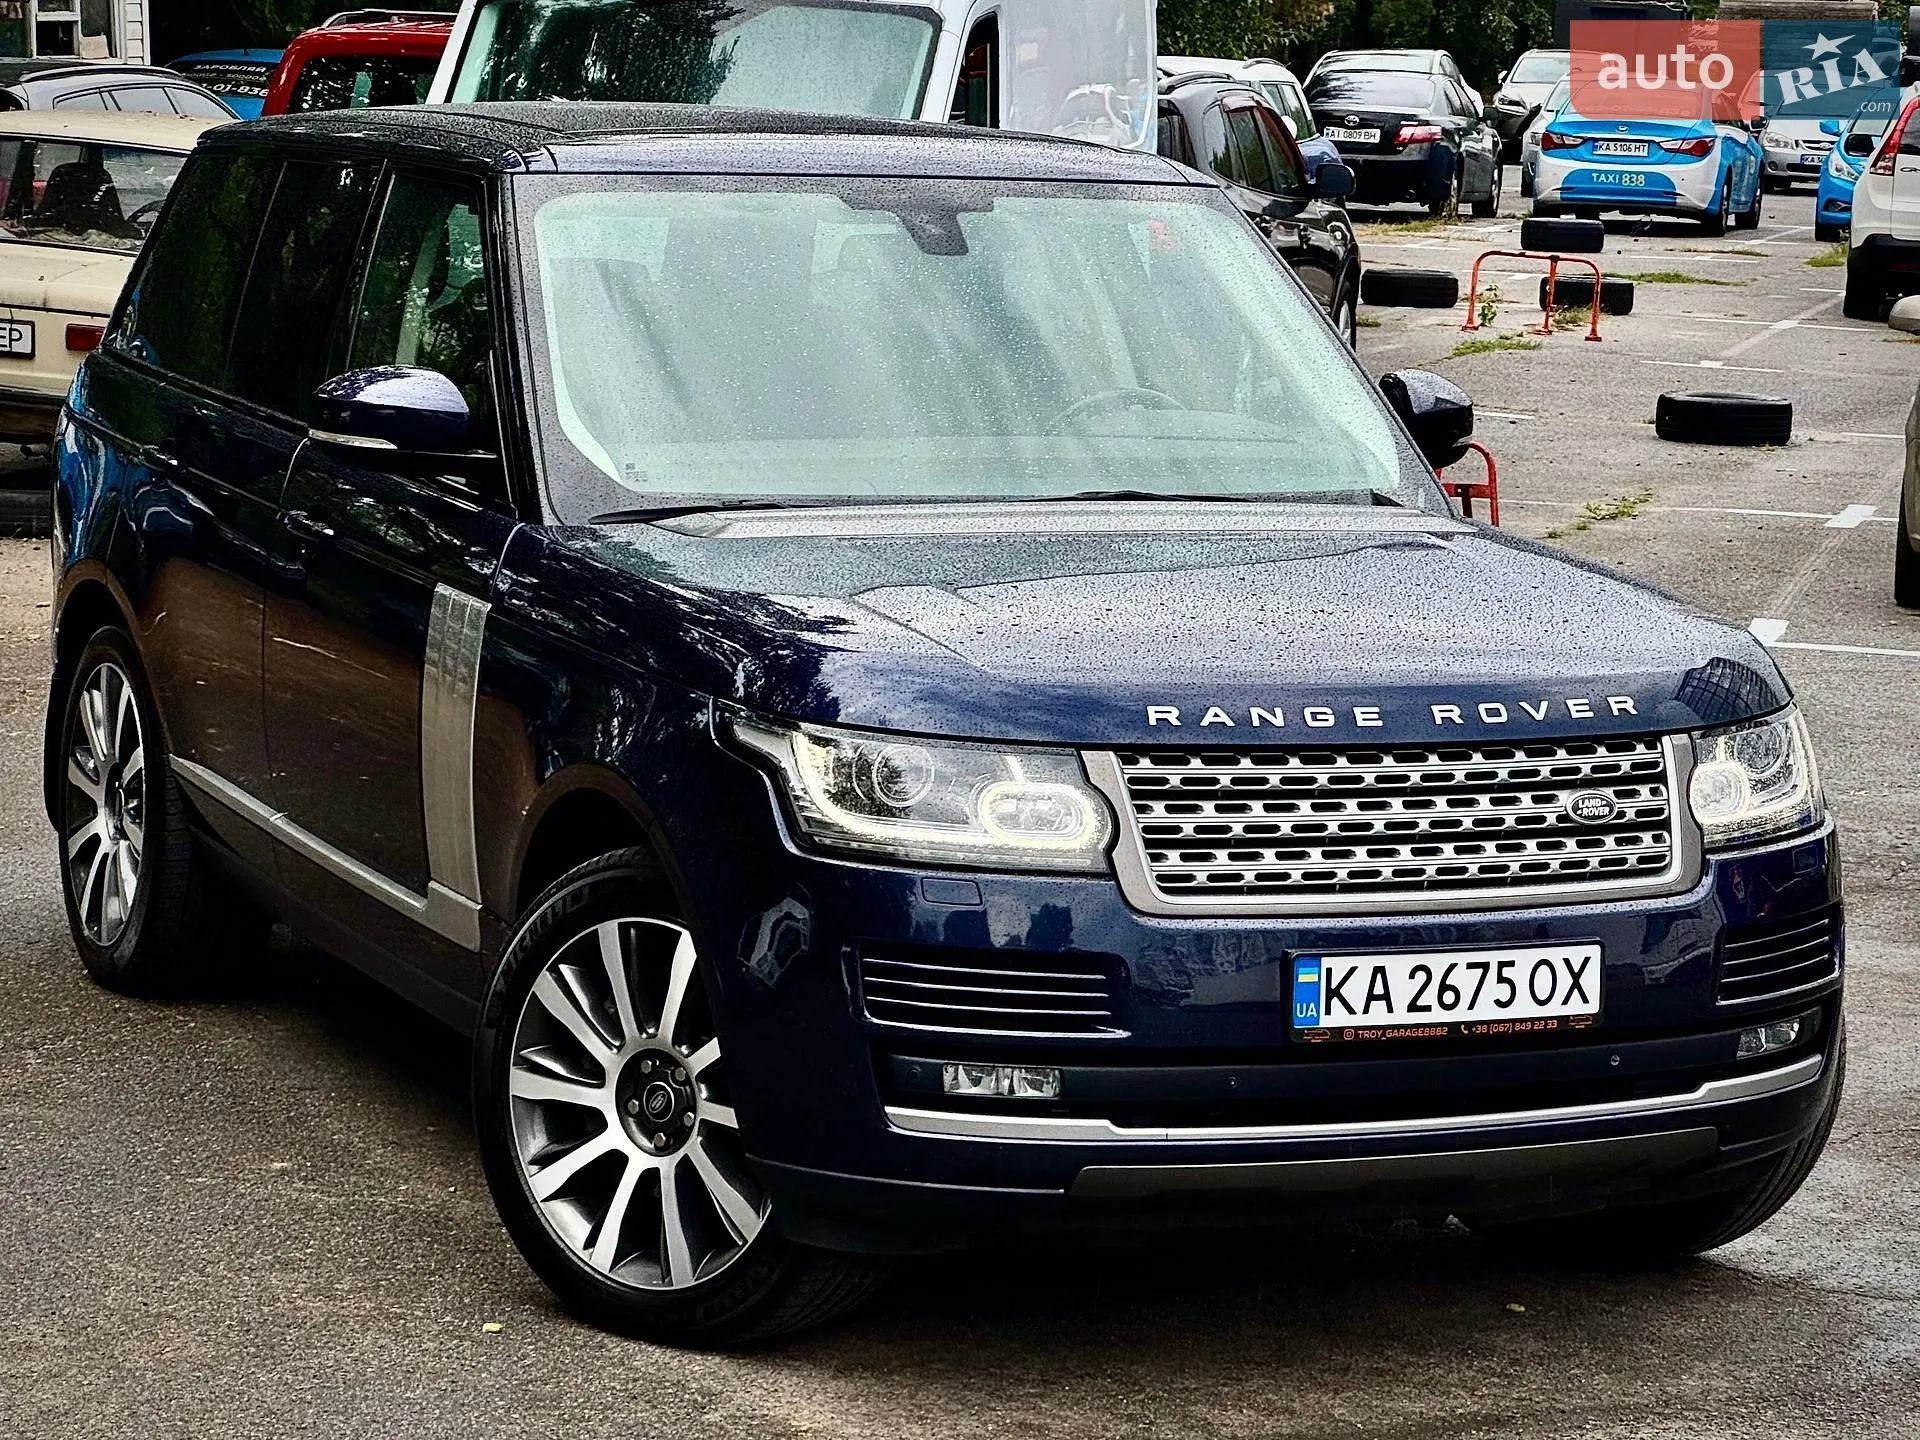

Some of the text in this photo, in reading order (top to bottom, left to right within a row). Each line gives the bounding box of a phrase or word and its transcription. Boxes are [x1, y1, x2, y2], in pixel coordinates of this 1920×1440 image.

[1343, 130, 1363, 139] 0809
[1599, 142, 1647, 152] KA 5106 HT
[1592, 173, 1645, 187] TAXI 838
[1146, 696, 1638, 728] RANGE ROVER
[1578, 798, 1602, 808] LAND
[1582, 806, 1610, 817] ROVER
[1325, 956, 1592, 1016] KA 2675 OX
[1296, 1002, 1318, 1018] UA
[1471, 1024, 1488, 1034] +38
[1514, 1022, 1532, 1031] 849
[1533, 1020, 1545, 1030] 22
[1546, 1019, 1558, 1029] 33
